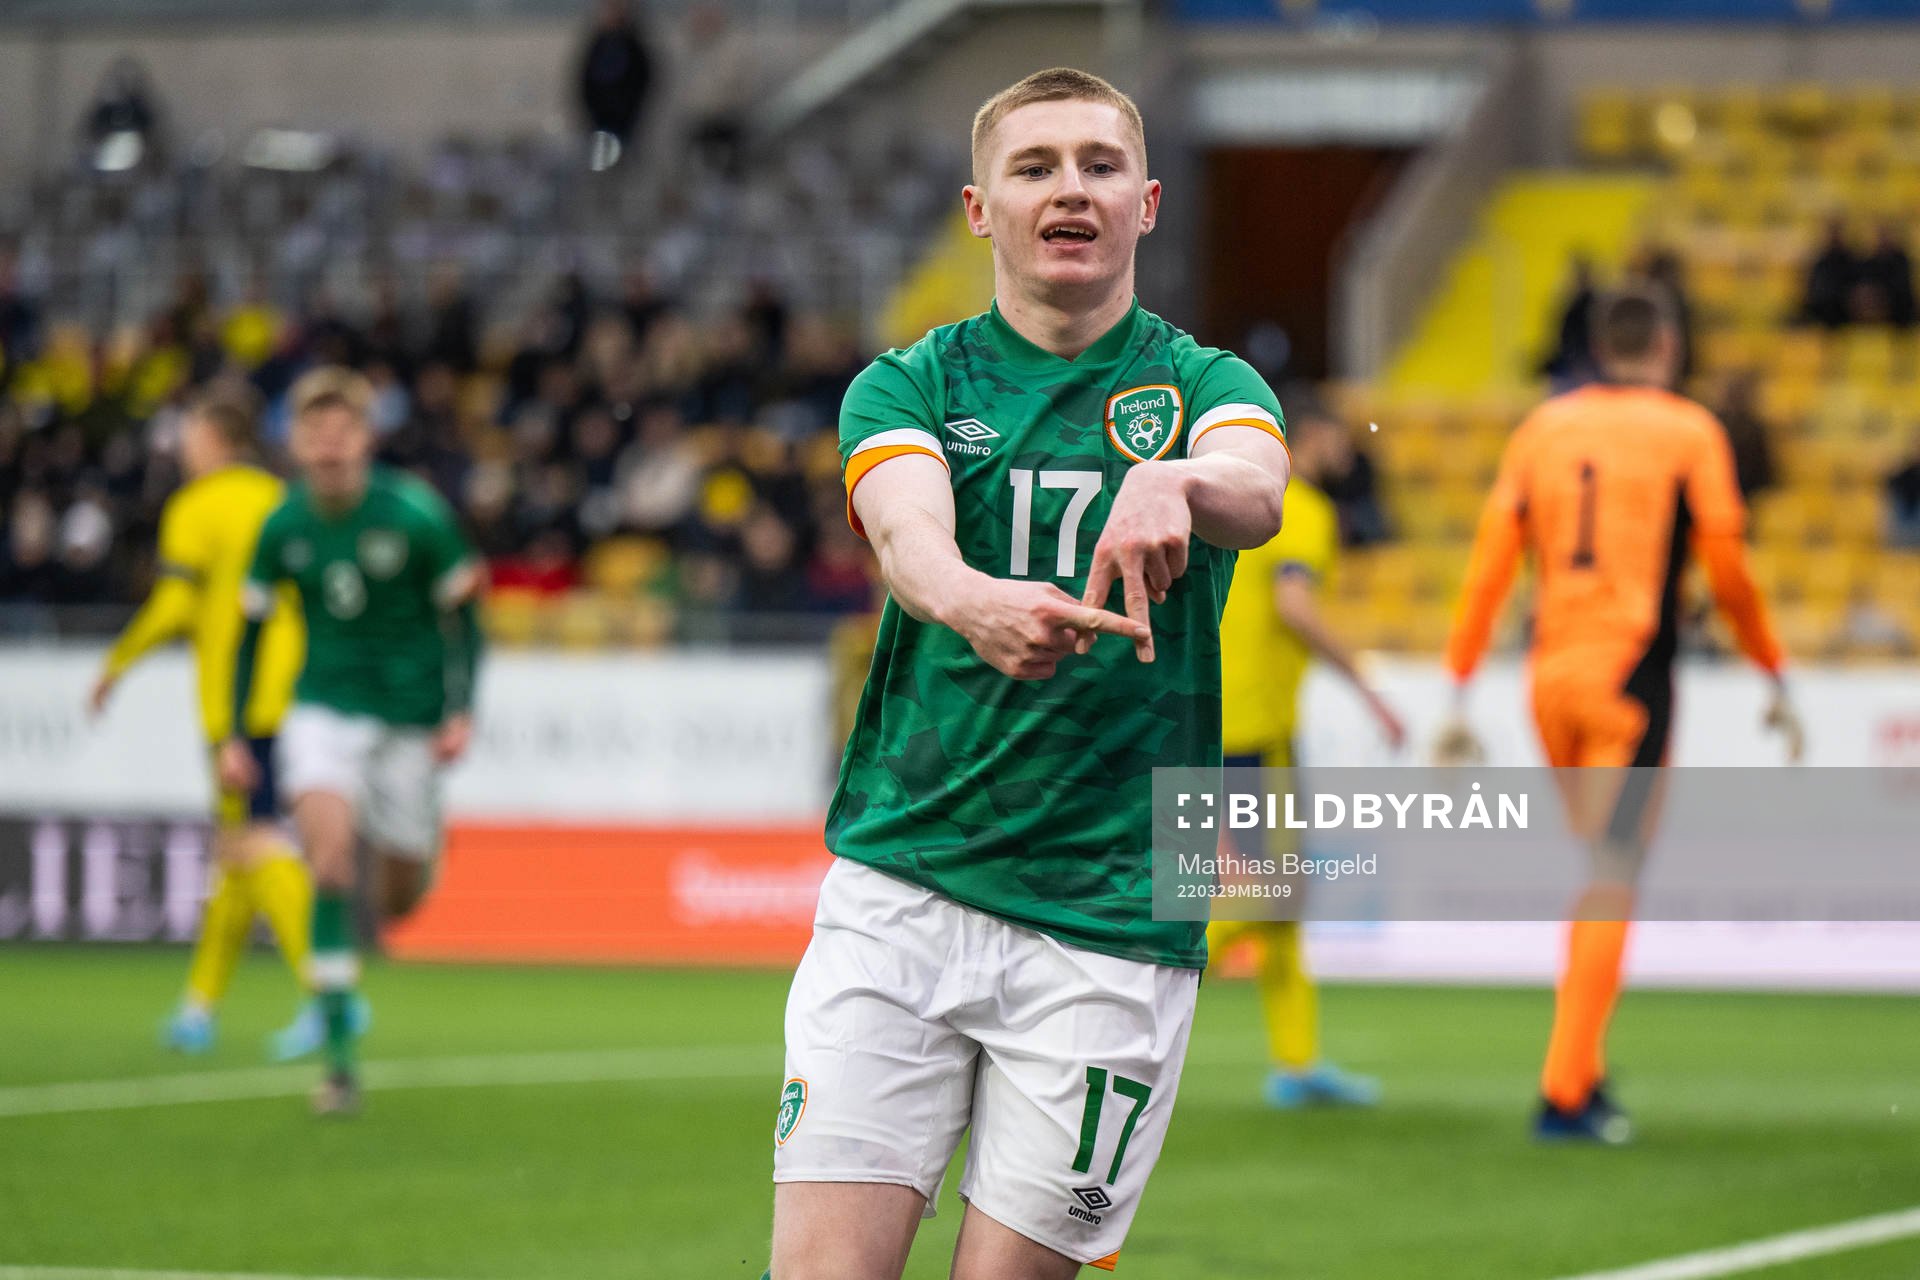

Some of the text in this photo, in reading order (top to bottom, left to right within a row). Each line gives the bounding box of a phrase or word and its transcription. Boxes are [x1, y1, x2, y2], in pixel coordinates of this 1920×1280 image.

[1119, 393, 1166, 415] Ireland
[946, 440, 991, 456] umbro
[1009, 468, 1102, 577] 17
[1571, 461, 1595, 568] 1
[1071, 1066, 1152, 1186] 17
[1068, 1204, 1102, 1225] umbro
